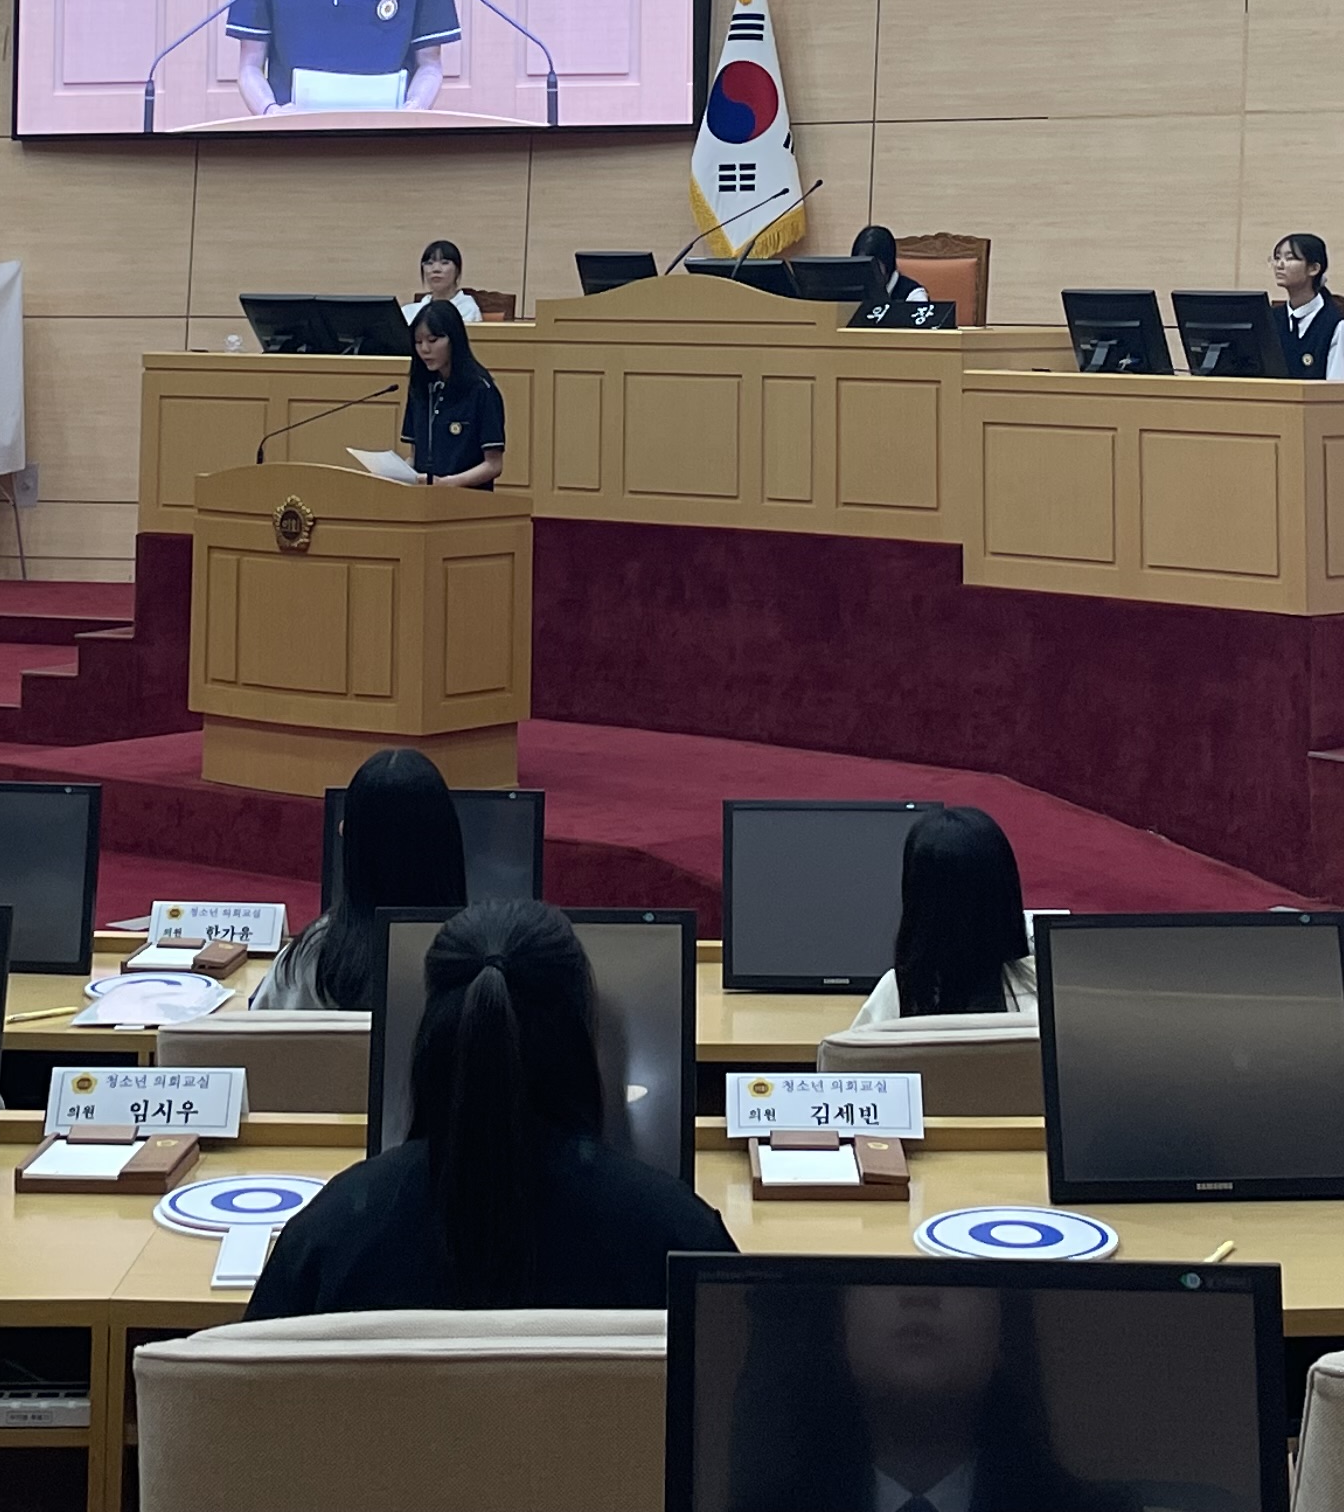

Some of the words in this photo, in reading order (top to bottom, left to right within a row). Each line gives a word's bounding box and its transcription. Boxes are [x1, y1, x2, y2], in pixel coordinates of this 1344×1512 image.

[106, 1074, 147, 1089] 청소년
[153, 1074, 210, 1089] 의회교실
[782, 1079, 824, 1093] 청소년
[831, 1079, 887, 1094] 의회교실
[67, 1105, 95, 1120] 의원
[130, 1099, 199, 1124] 임시우
[748, 1108, 776, 1122] 의원
